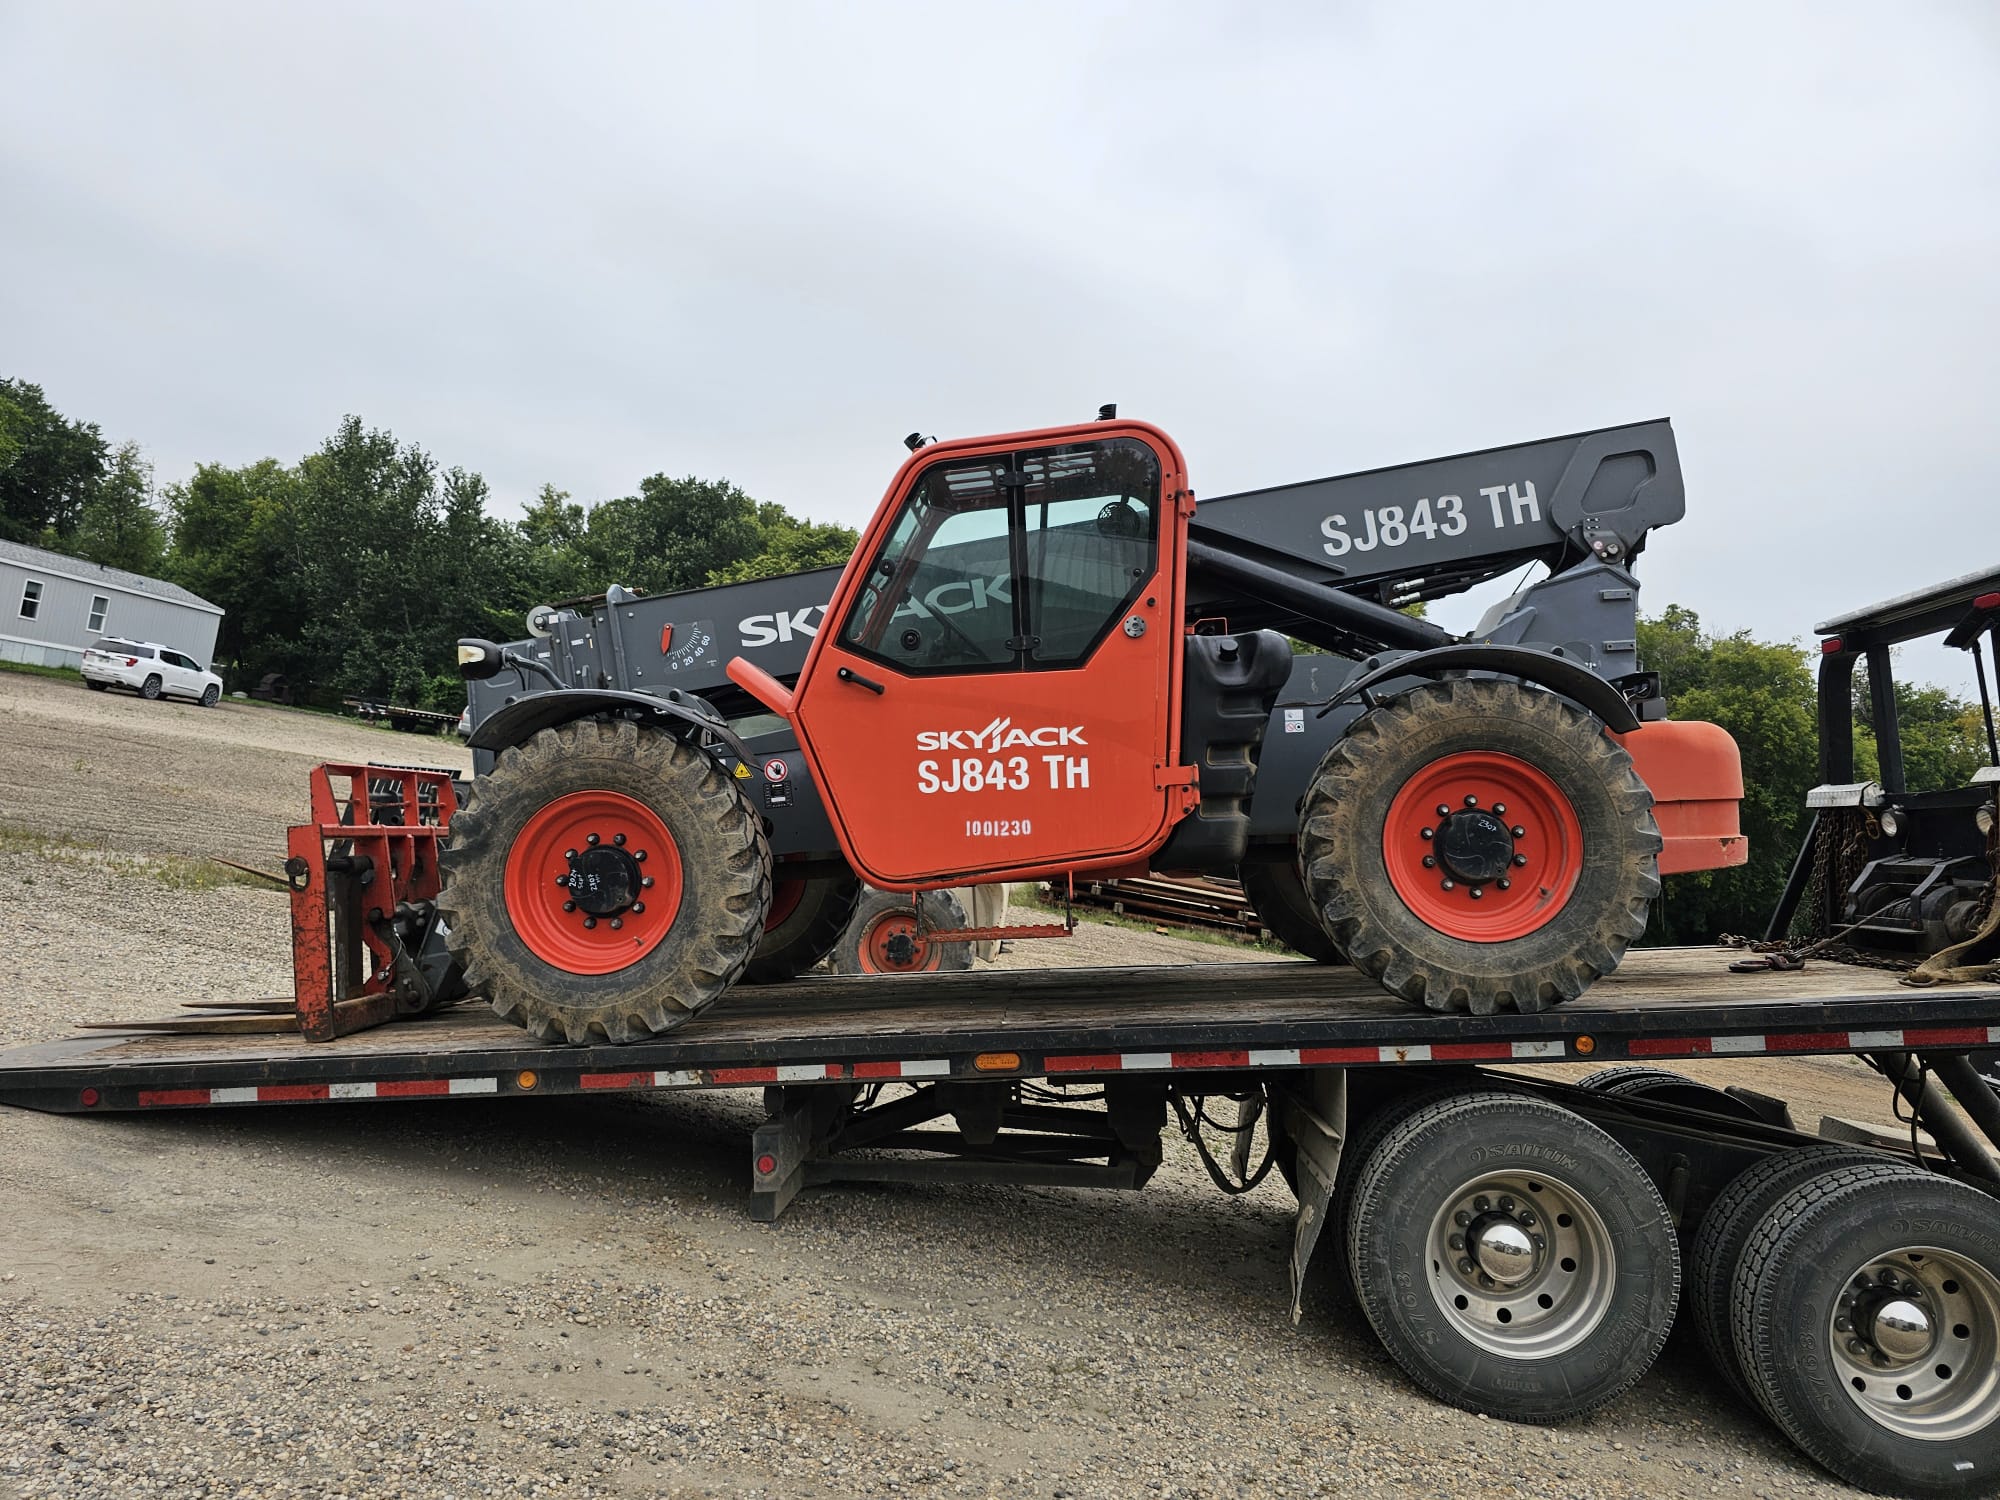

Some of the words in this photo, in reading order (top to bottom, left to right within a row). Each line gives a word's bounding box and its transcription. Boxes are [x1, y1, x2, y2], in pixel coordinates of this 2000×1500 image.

[1320, 494, 1468, 557] SJ843
[1479, 479, 1542, 529] TH
[672, 662, 678, 670] 0
[683, 656, 694, 666] 20
[694, 646, 704, 657] 40
[701, 635, 711, 646] 60
[916, 716, 1089, 754] SKYJACK
[917, 756, 1031, 794] SJ843
[1042, 754, 1090, 790] TH
[965, 819, 1033, 837] 1001230
